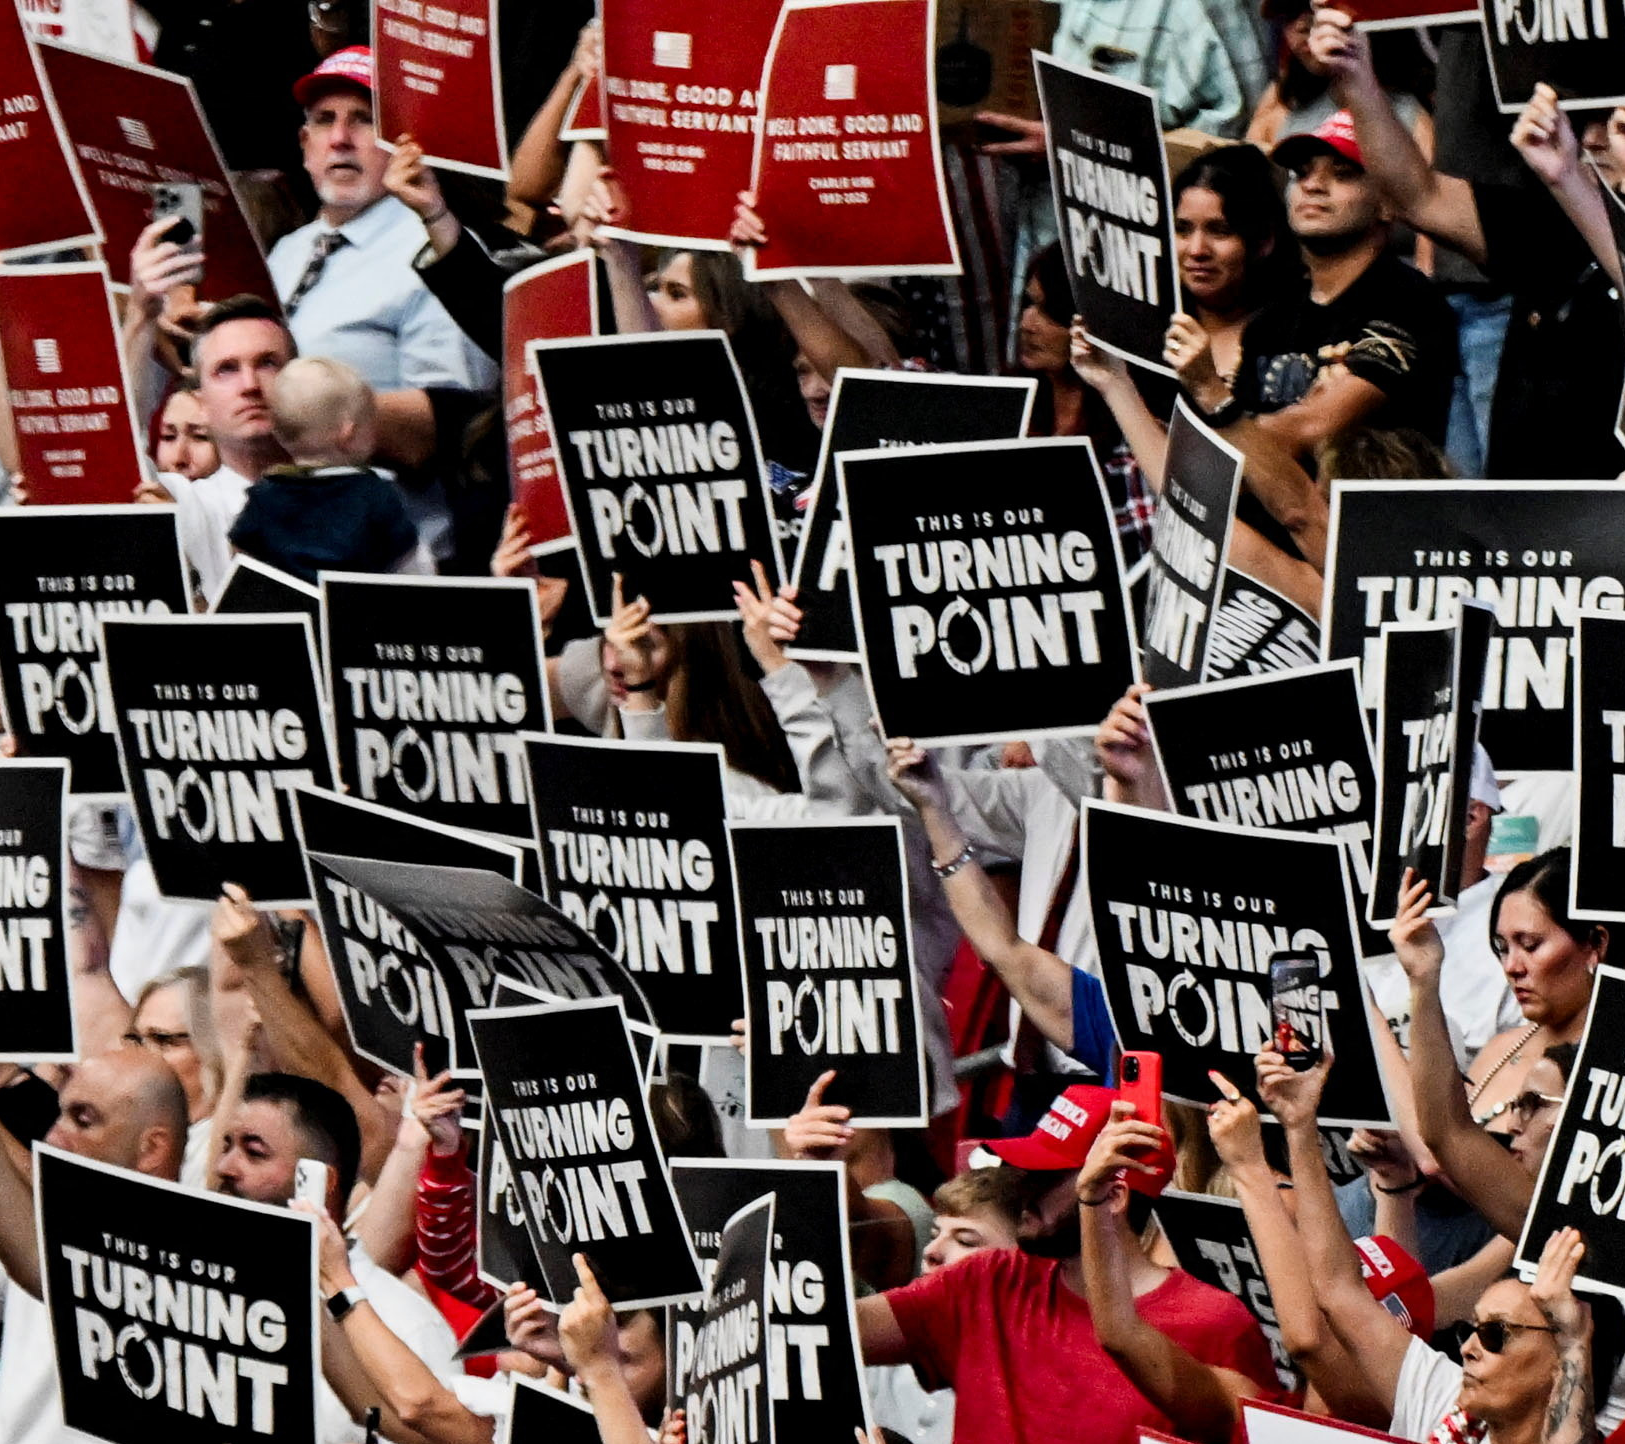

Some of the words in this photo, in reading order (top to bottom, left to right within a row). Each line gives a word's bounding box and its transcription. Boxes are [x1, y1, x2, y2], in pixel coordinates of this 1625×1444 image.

[916, 513, 962, 532] THIS
[973, 512, 993, 528] IS
[1004, 508, 1044, 525] OUR
[874, 531, 1097, 597] TURNING
[103, 1233, 148, 1260] THIS
[159, 1250, 180, 1269] IS
[191, 1259, 235, 1283] OUR
[62, 1244, 287, 1352] TURNING
